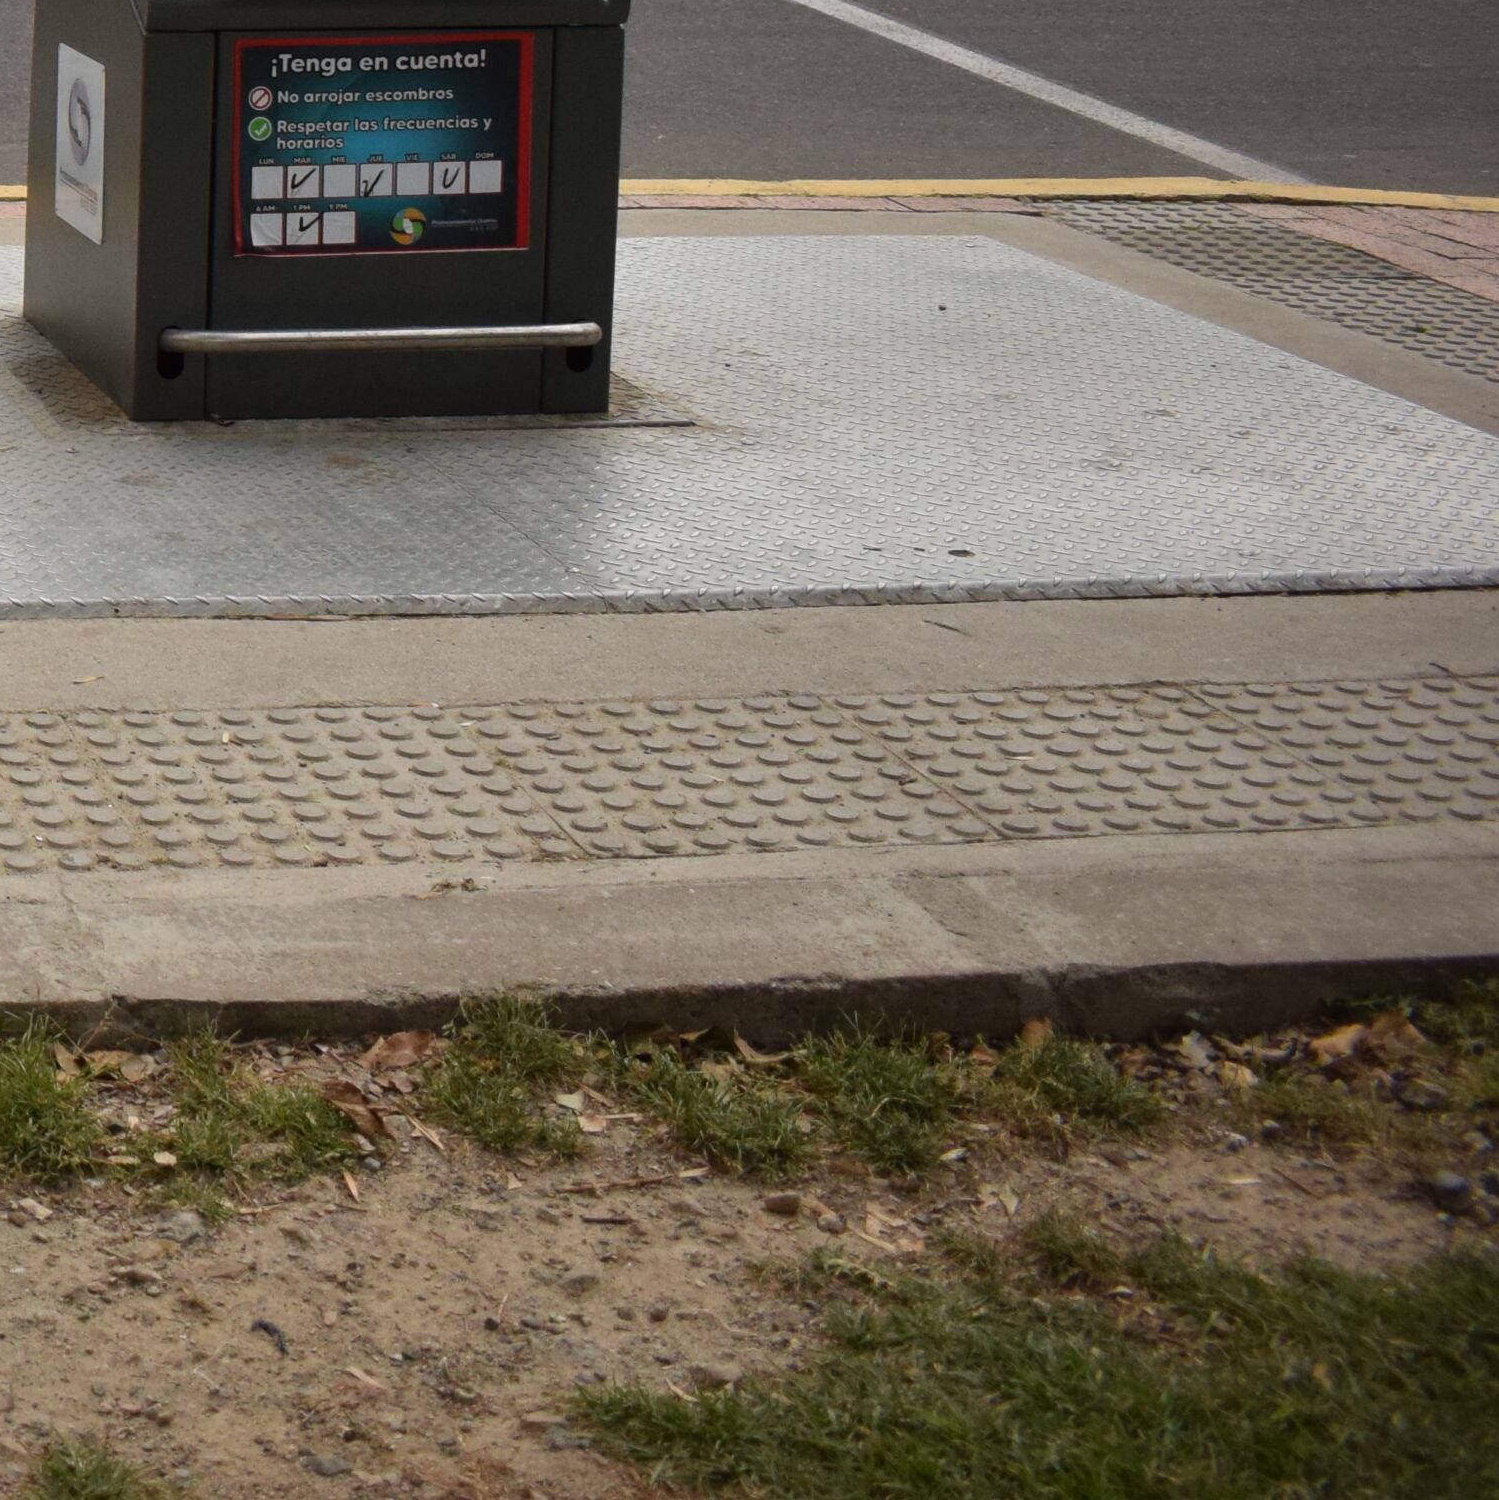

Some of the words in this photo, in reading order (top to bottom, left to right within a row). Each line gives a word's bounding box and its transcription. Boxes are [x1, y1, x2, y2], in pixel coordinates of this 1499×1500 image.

[271, 53, 352, 78] ¡Tenga
[359, 56, 388, 71] en
[395, 49, 486, 70] cuenta!
[277, 90, 299, 103] No
[303, 89, 360, 105] arrojar
[365, 87, 454, 102] escombros
[277, 120, 349, 135] Respetar
[354, 118, 378, 131] las
[384, 115, 478, 130] frecuencias
[483, 117, 492, 131] y
[276, 135, 344, 150] horarios
